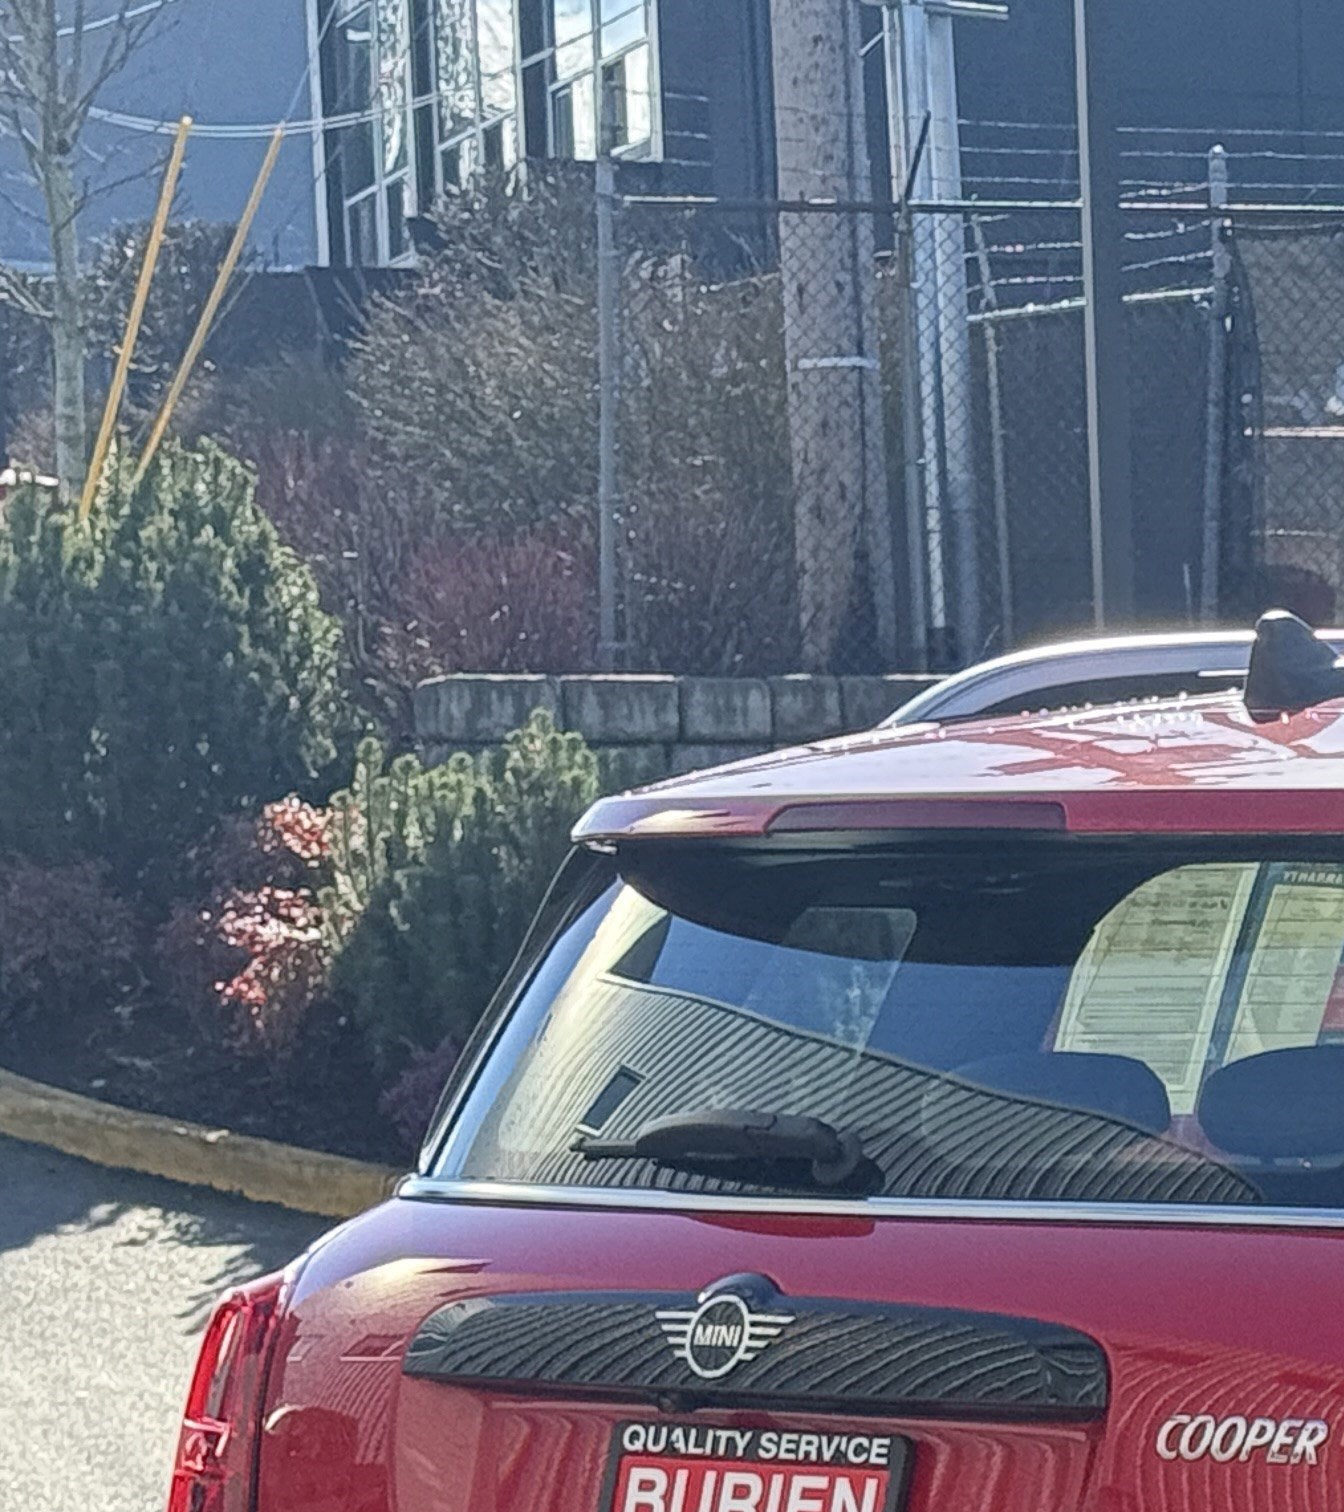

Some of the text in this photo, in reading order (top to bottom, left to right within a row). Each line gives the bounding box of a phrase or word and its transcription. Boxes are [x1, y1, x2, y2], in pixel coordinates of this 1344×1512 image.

[693, 1324, 742, 1347] MINI
[622, 1424, 891, 1465] QUALITY SERVICE
[1156, 1414, 1328, 1466] COOPER
